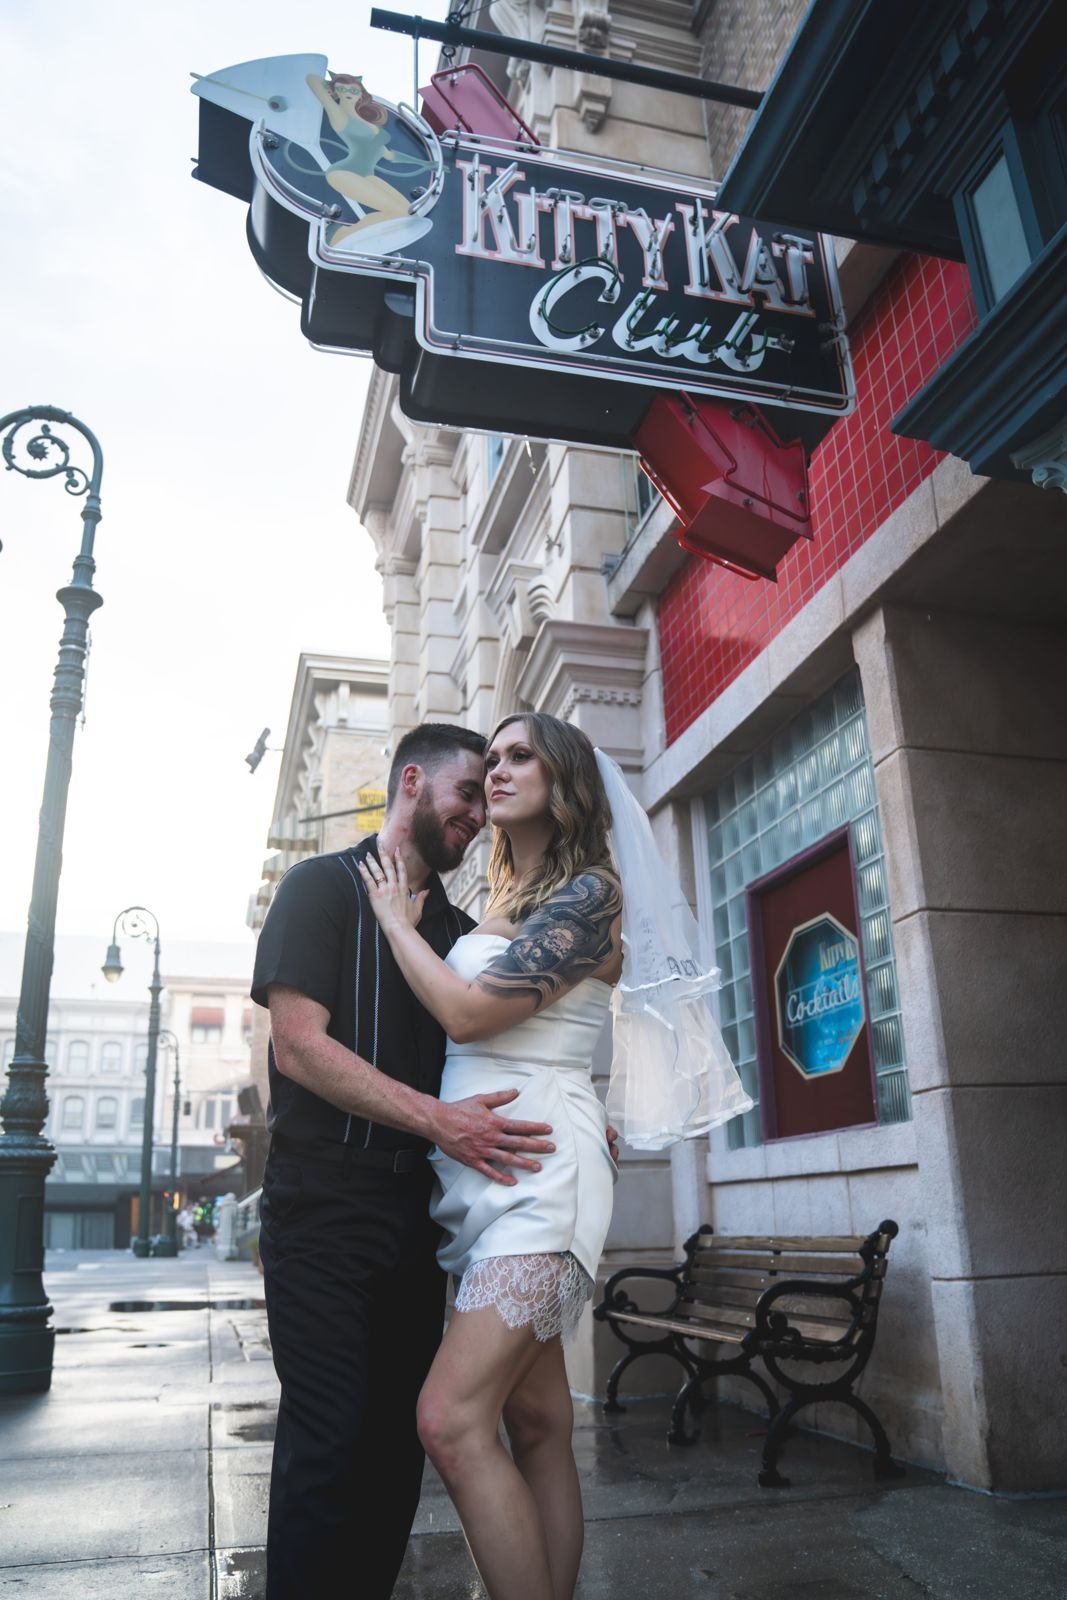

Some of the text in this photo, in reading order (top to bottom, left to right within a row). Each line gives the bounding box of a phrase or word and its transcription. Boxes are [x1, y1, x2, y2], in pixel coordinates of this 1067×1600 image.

[455, 155, 816, 318] KITTY KAT
[529, 257, 786, 372] Club
